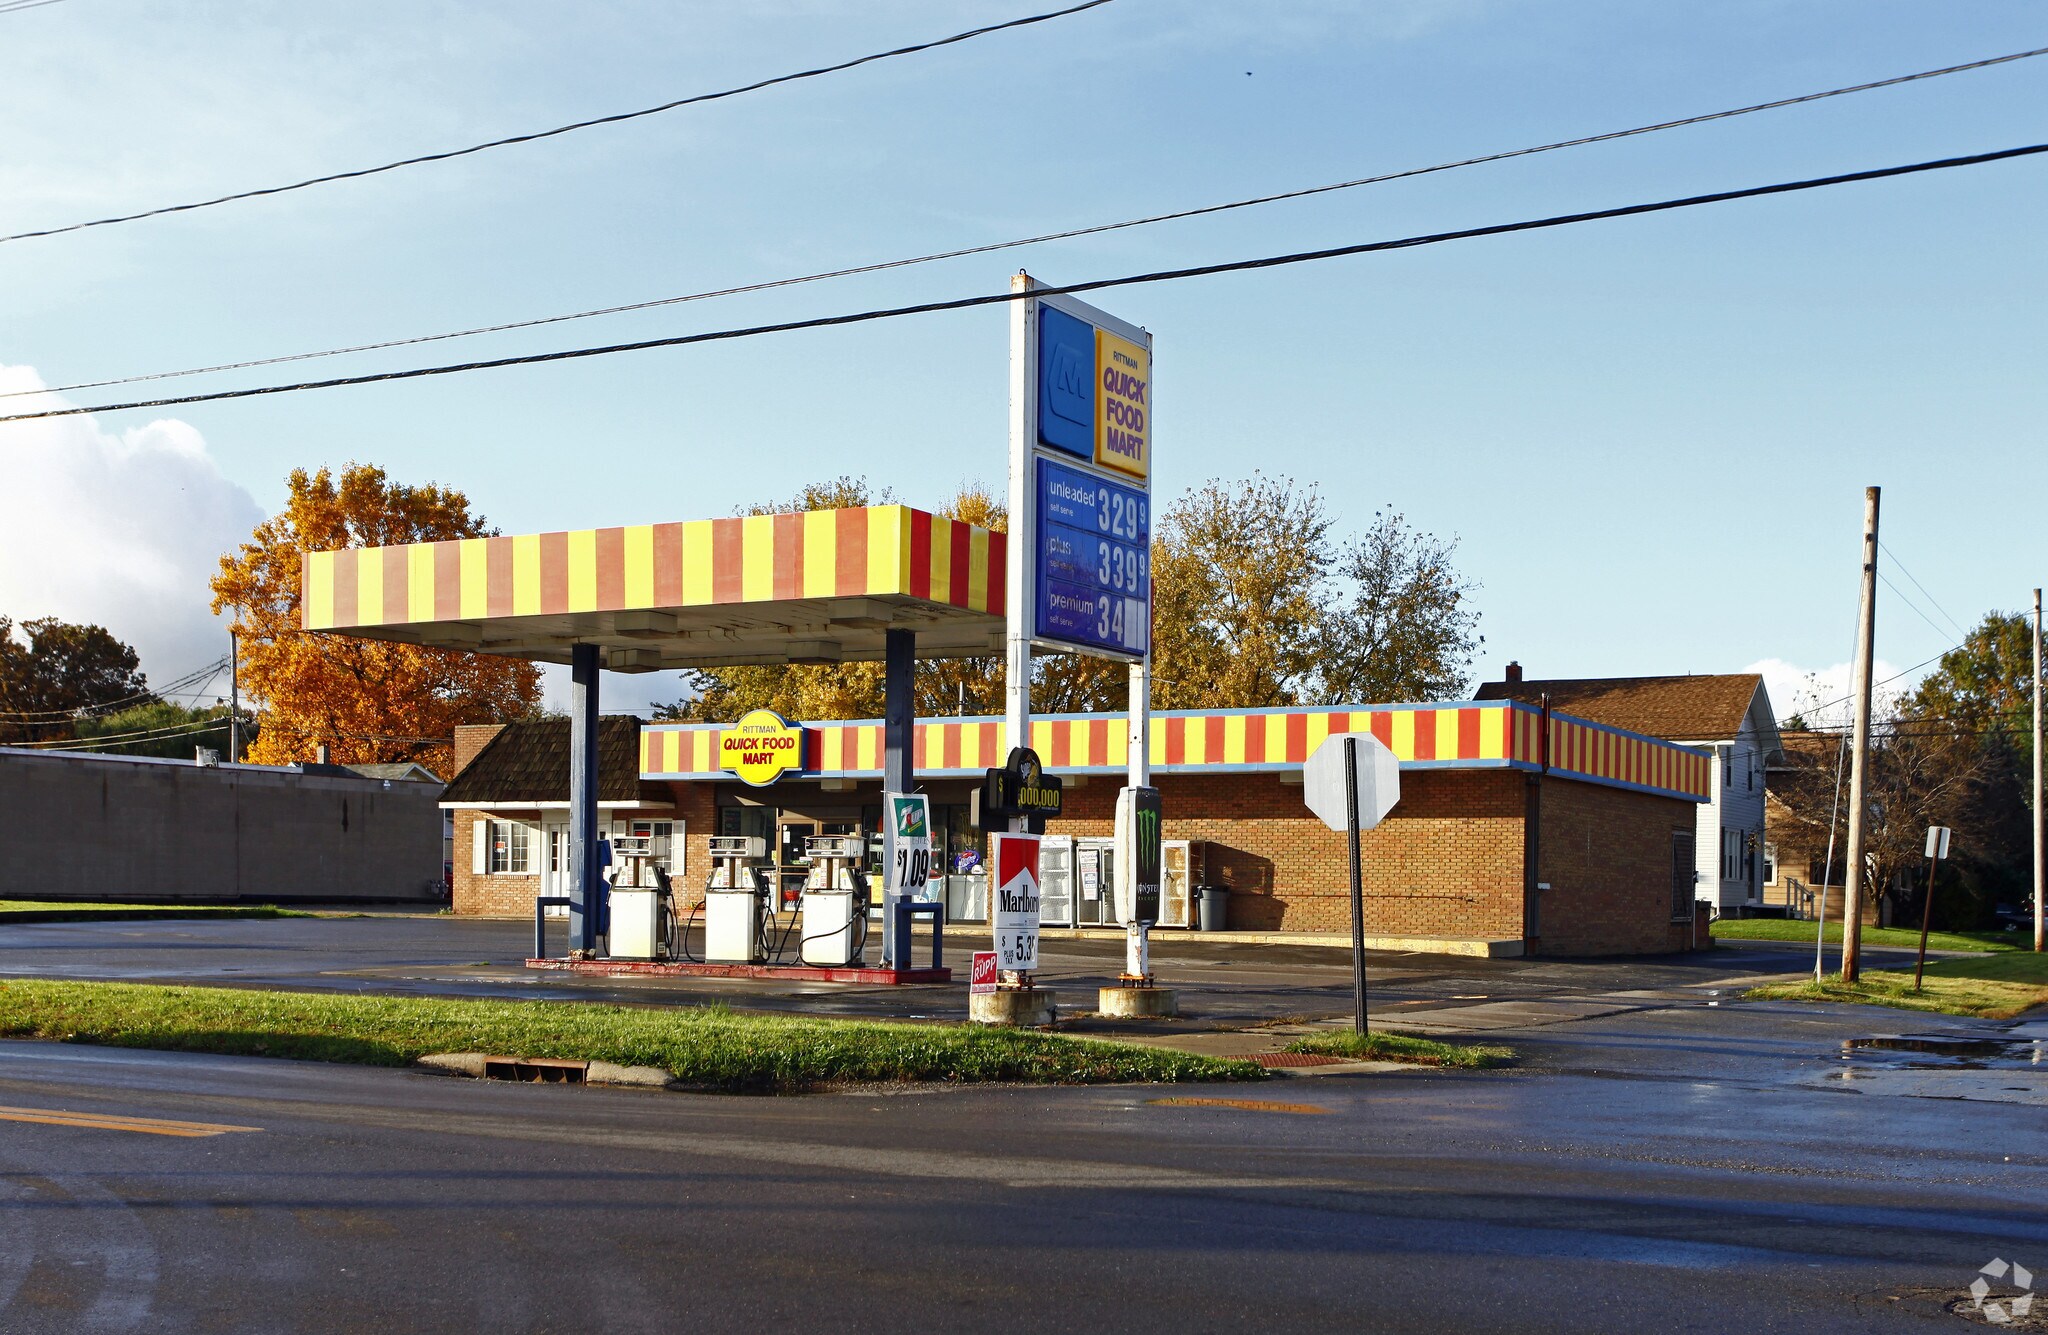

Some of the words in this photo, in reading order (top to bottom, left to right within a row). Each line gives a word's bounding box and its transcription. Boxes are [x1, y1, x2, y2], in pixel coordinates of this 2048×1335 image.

[1113, 350, 1138, 370] RITTMAN
[1103, 366, 1146, 405] QUICK
[1106, 397, 1144, 433] FOOD
[1106, 426, 1144, 461] MART
[1050, 481, 1095, 507] unleaded
[1098, 488, 1137, 540] 329
[1050, 535, 1071, 555] plus
[1098, 542, 1137, 593] 339
[1050, 593, 1094, 615] premium
[742, 725, 777, 734] RITTMAN
[723, 737, 760, 750] QUICK
[762, 737, 795, 750] FOOD
[742, 752, 775, 765] MART
[897, 848, 929, 887] $1.09
[1000, 884, 1039, 913] Marlboro
[1001, 935, 1006, 948] $
[1004, 949, 1014, 958] PLUS
[974, 955, 996, 983] RUPP
[1005, 957, 1013, 965] TAX
